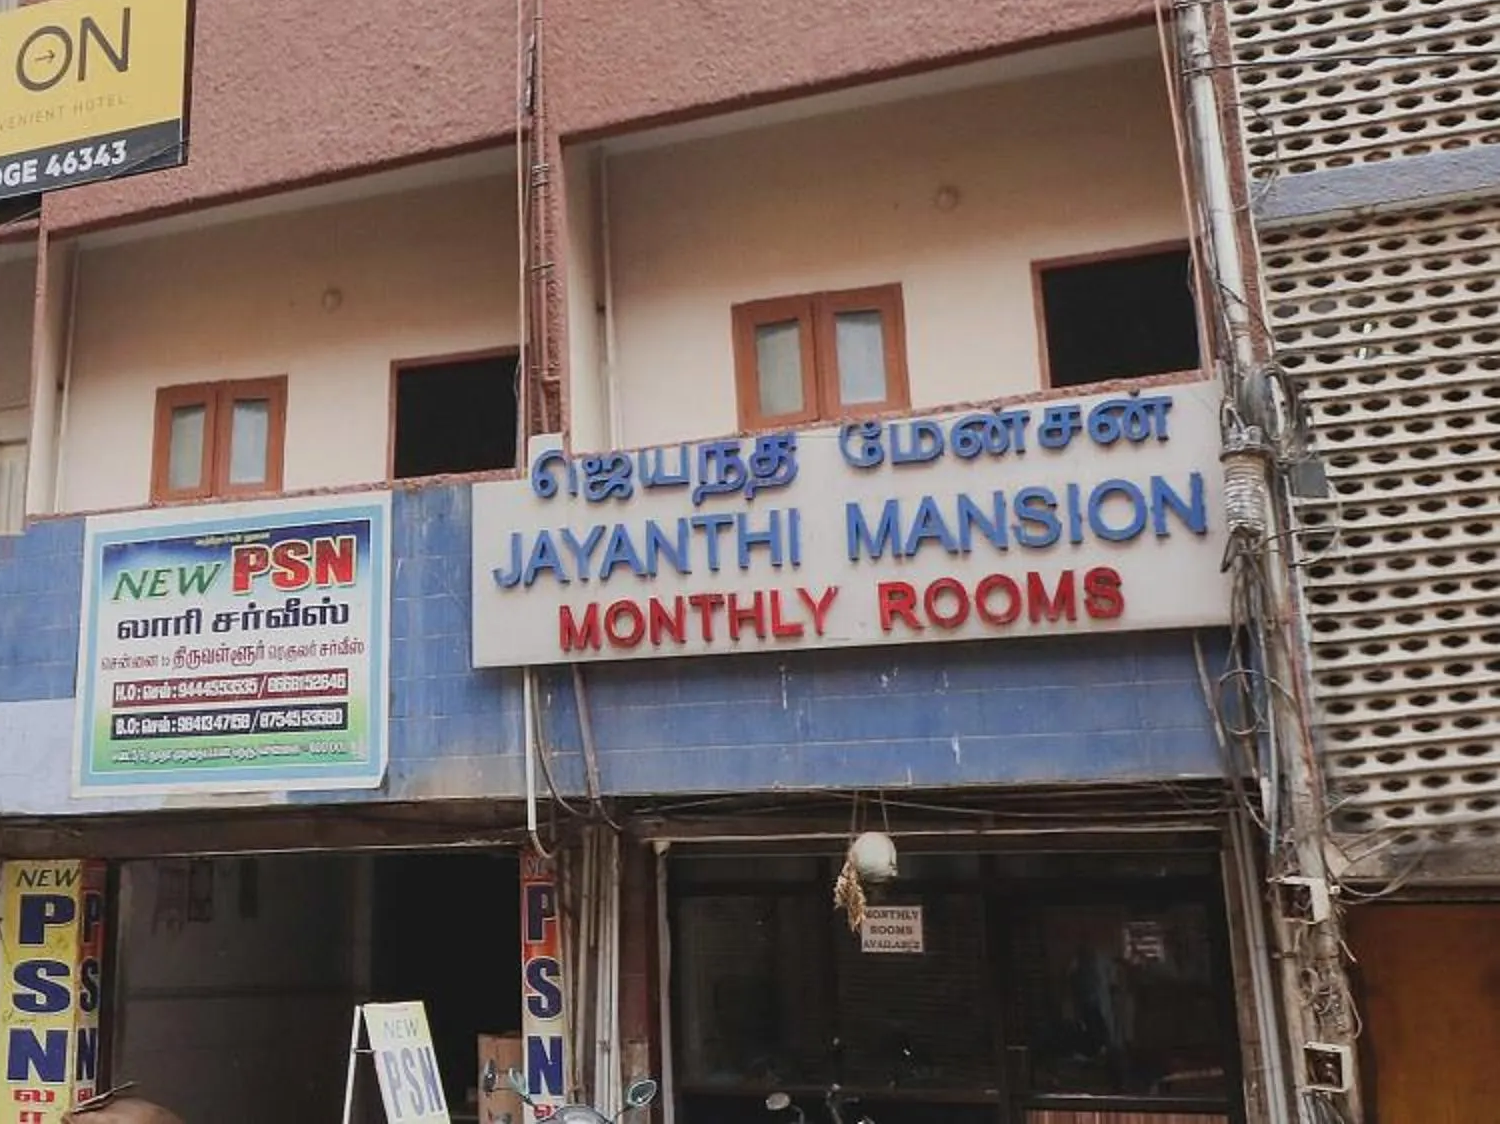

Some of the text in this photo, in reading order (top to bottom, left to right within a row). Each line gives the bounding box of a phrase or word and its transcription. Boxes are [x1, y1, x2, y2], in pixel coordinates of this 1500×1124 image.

[16, 7, 131, 92] ON
[73, 92, 128, 117] HOTEL
[45, 139, 128, 178] 46343
[494, 472, 1207, 589] JAYANTHI MANSION
[111, 534, 357, 601] NEW PSN
[117, 607, 202, 640] லாரி
[558, 567, 1125, 653] MONTHLY ROOMS
[16, 869, 80, 887] NEW
[7, 893, 76, 1083] PSN
